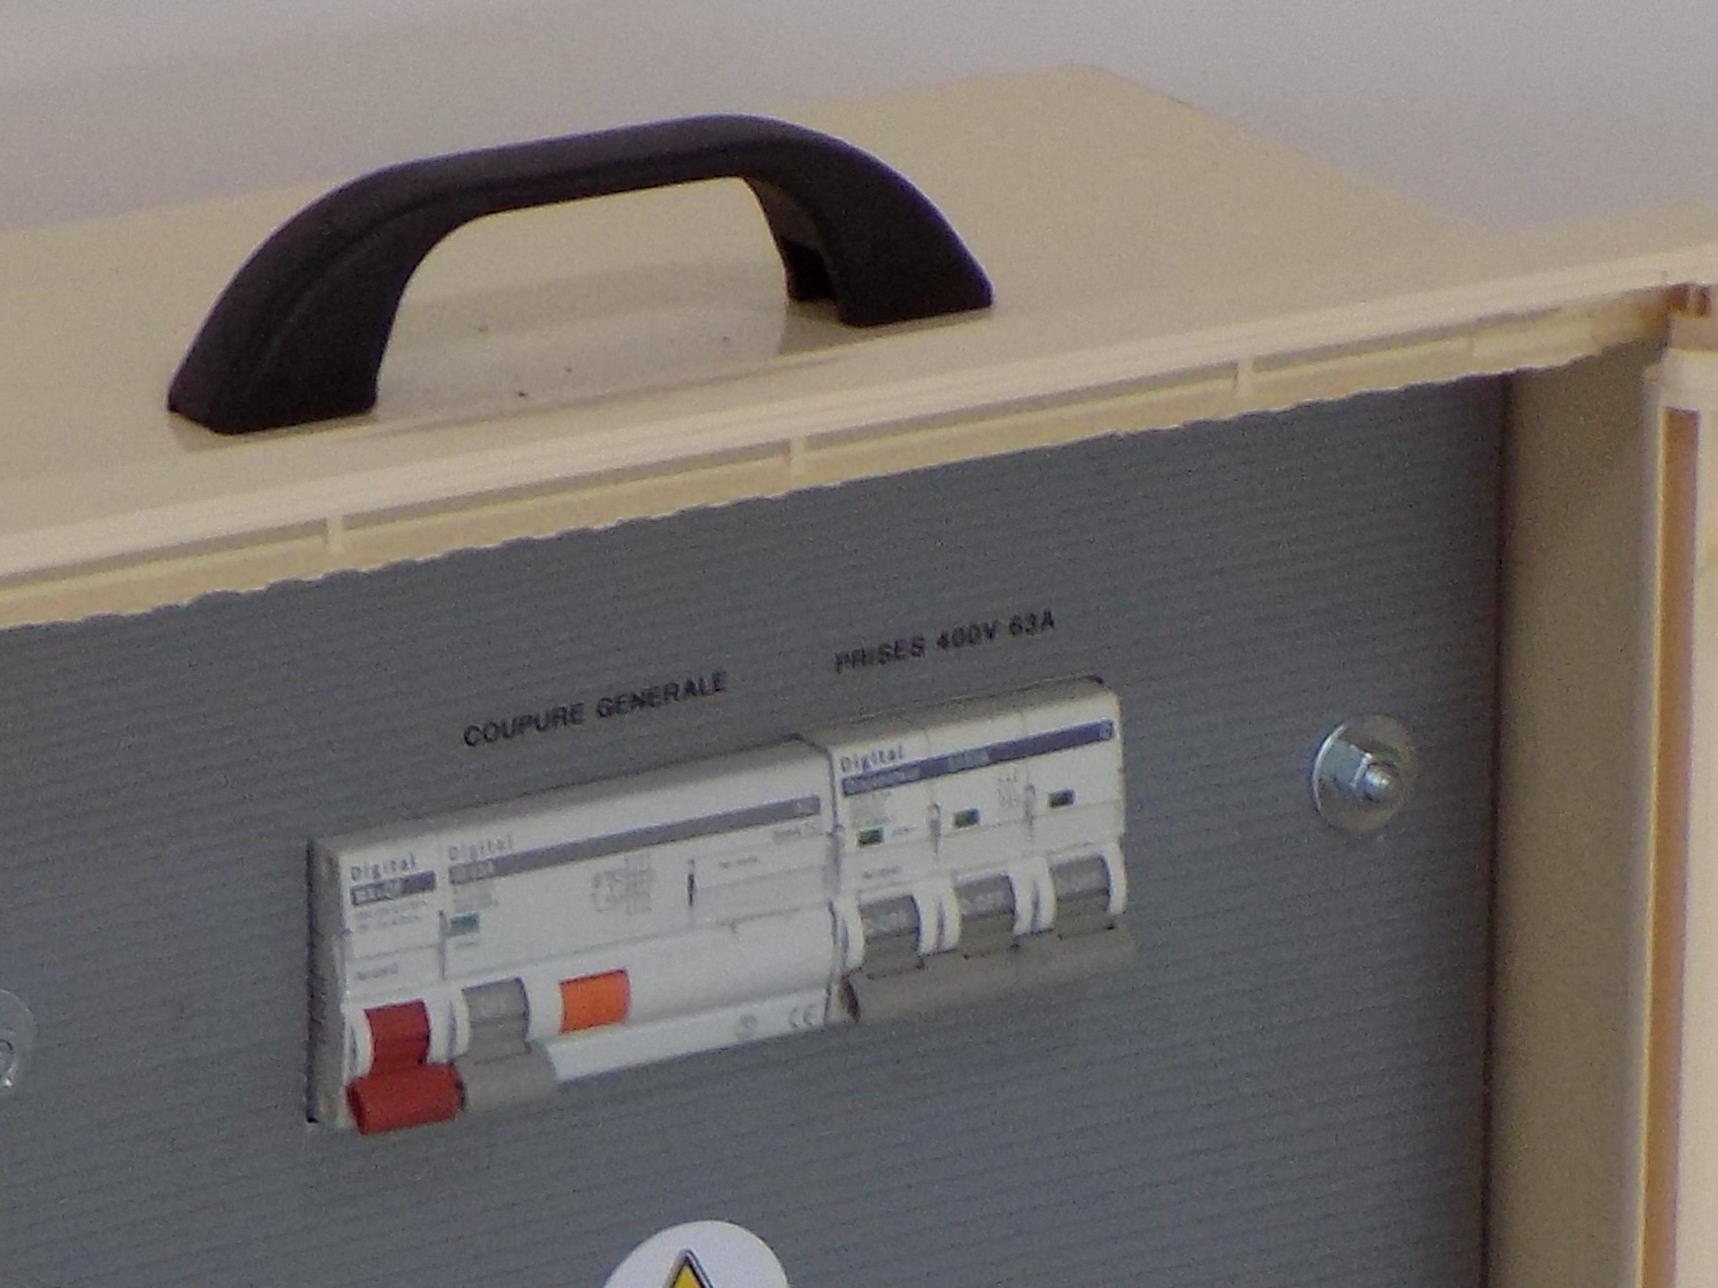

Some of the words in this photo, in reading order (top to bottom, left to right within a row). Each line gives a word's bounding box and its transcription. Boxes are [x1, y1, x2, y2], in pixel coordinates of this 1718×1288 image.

[834, 635, 926, 674] PRISES
[936, 618, 999, 651] 400V
[1009, 610, 1055, 637] 63A
[463, 703, 583, 748] COUPURE
[596, 670, 728, 720] GENERALE
[841, 744, 904, 772] Digital
[448, 834, 514, 861] Digital
[350, 852, 417, 881] Digital
